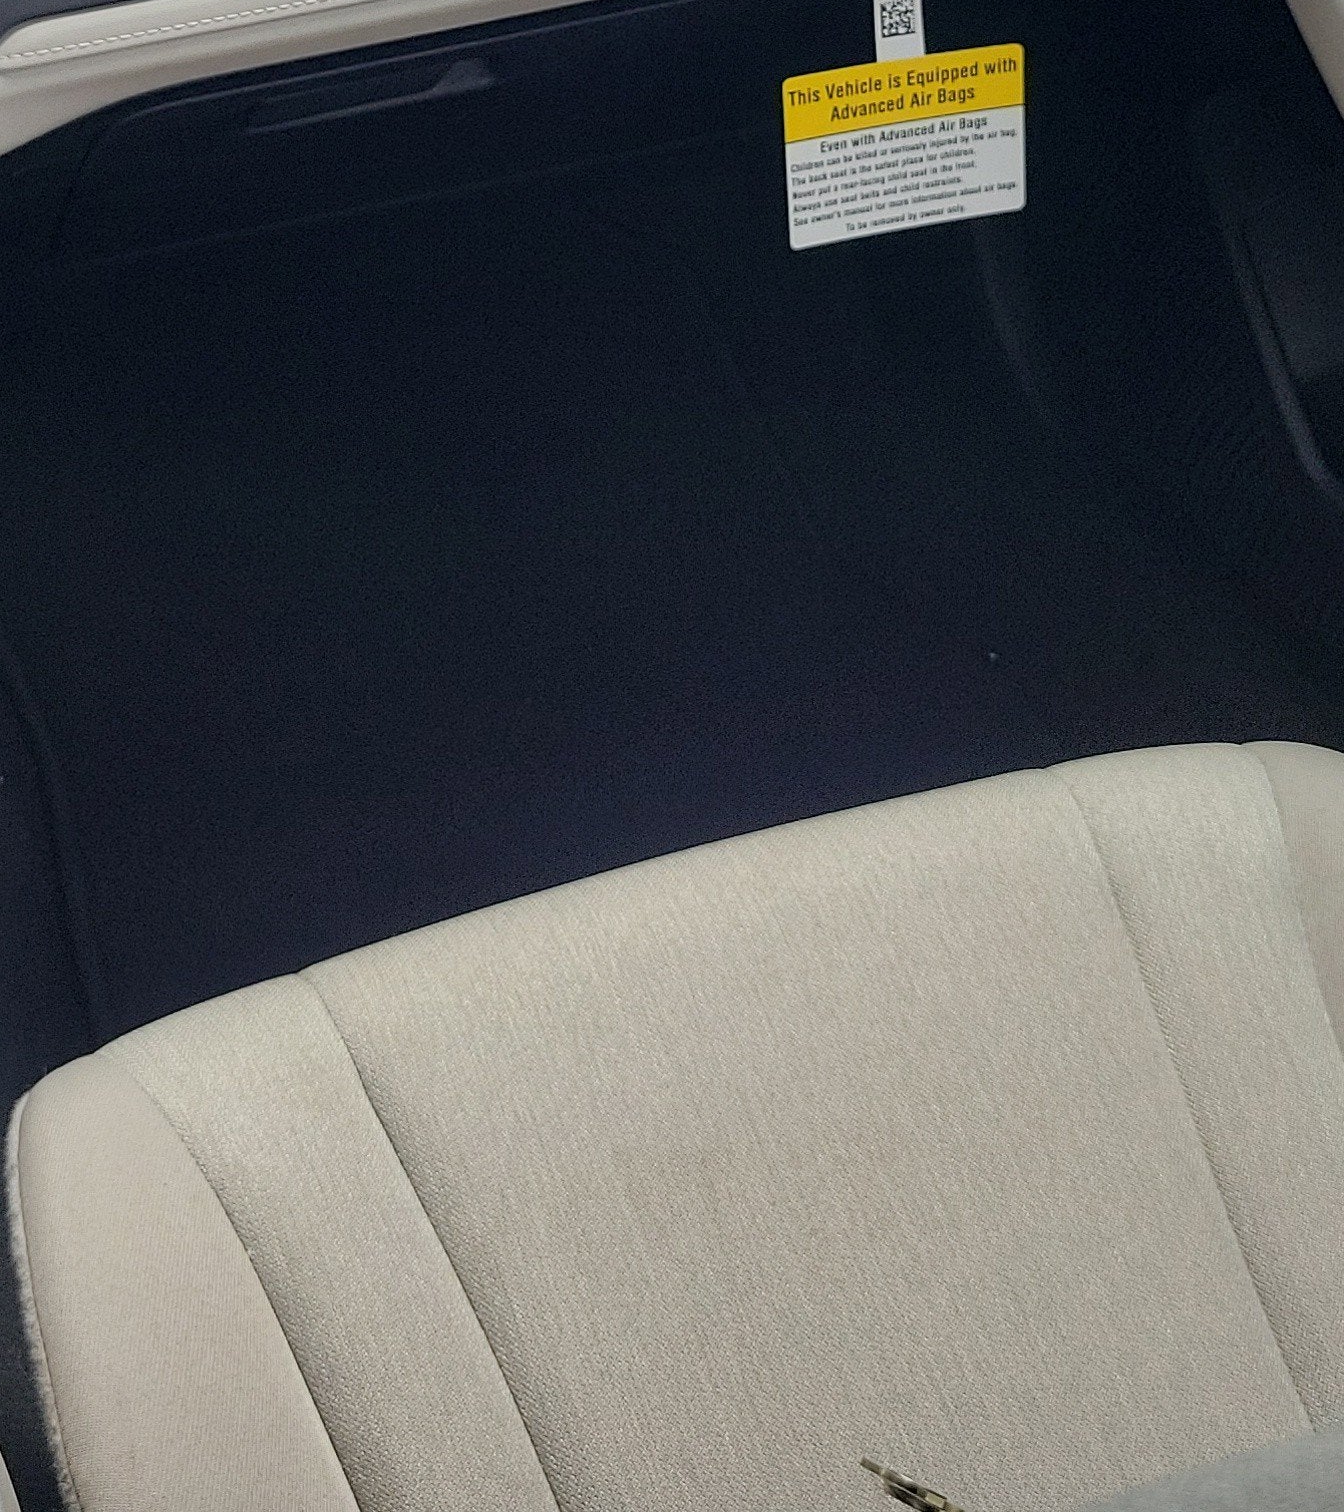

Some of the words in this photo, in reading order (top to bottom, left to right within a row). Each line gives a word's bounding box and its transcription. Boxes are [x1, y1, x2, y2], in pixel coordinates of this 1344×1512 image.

[788, 87, 821, 107] This
[824, 77, 882, 100] Vehicle
[887, 73, 902, 90] is
[906, 61, 979, 88] Equipped
[984, 57, 1017, 76] with
[830, 95, 905, 122] Advanced
[910, 91, 933, 108] Air
[937, 87, 975, 105] Bags
[820, 140, 847, 153] Even
[851, 133, 876, 147] with
[878, 122, 935, 143] Advanced
[938, 119, 956, 133] Air
[959, 115, 988, 131] Bags
[790, 160, 825, 173] Children
[929, 136, 958, 149] injured
